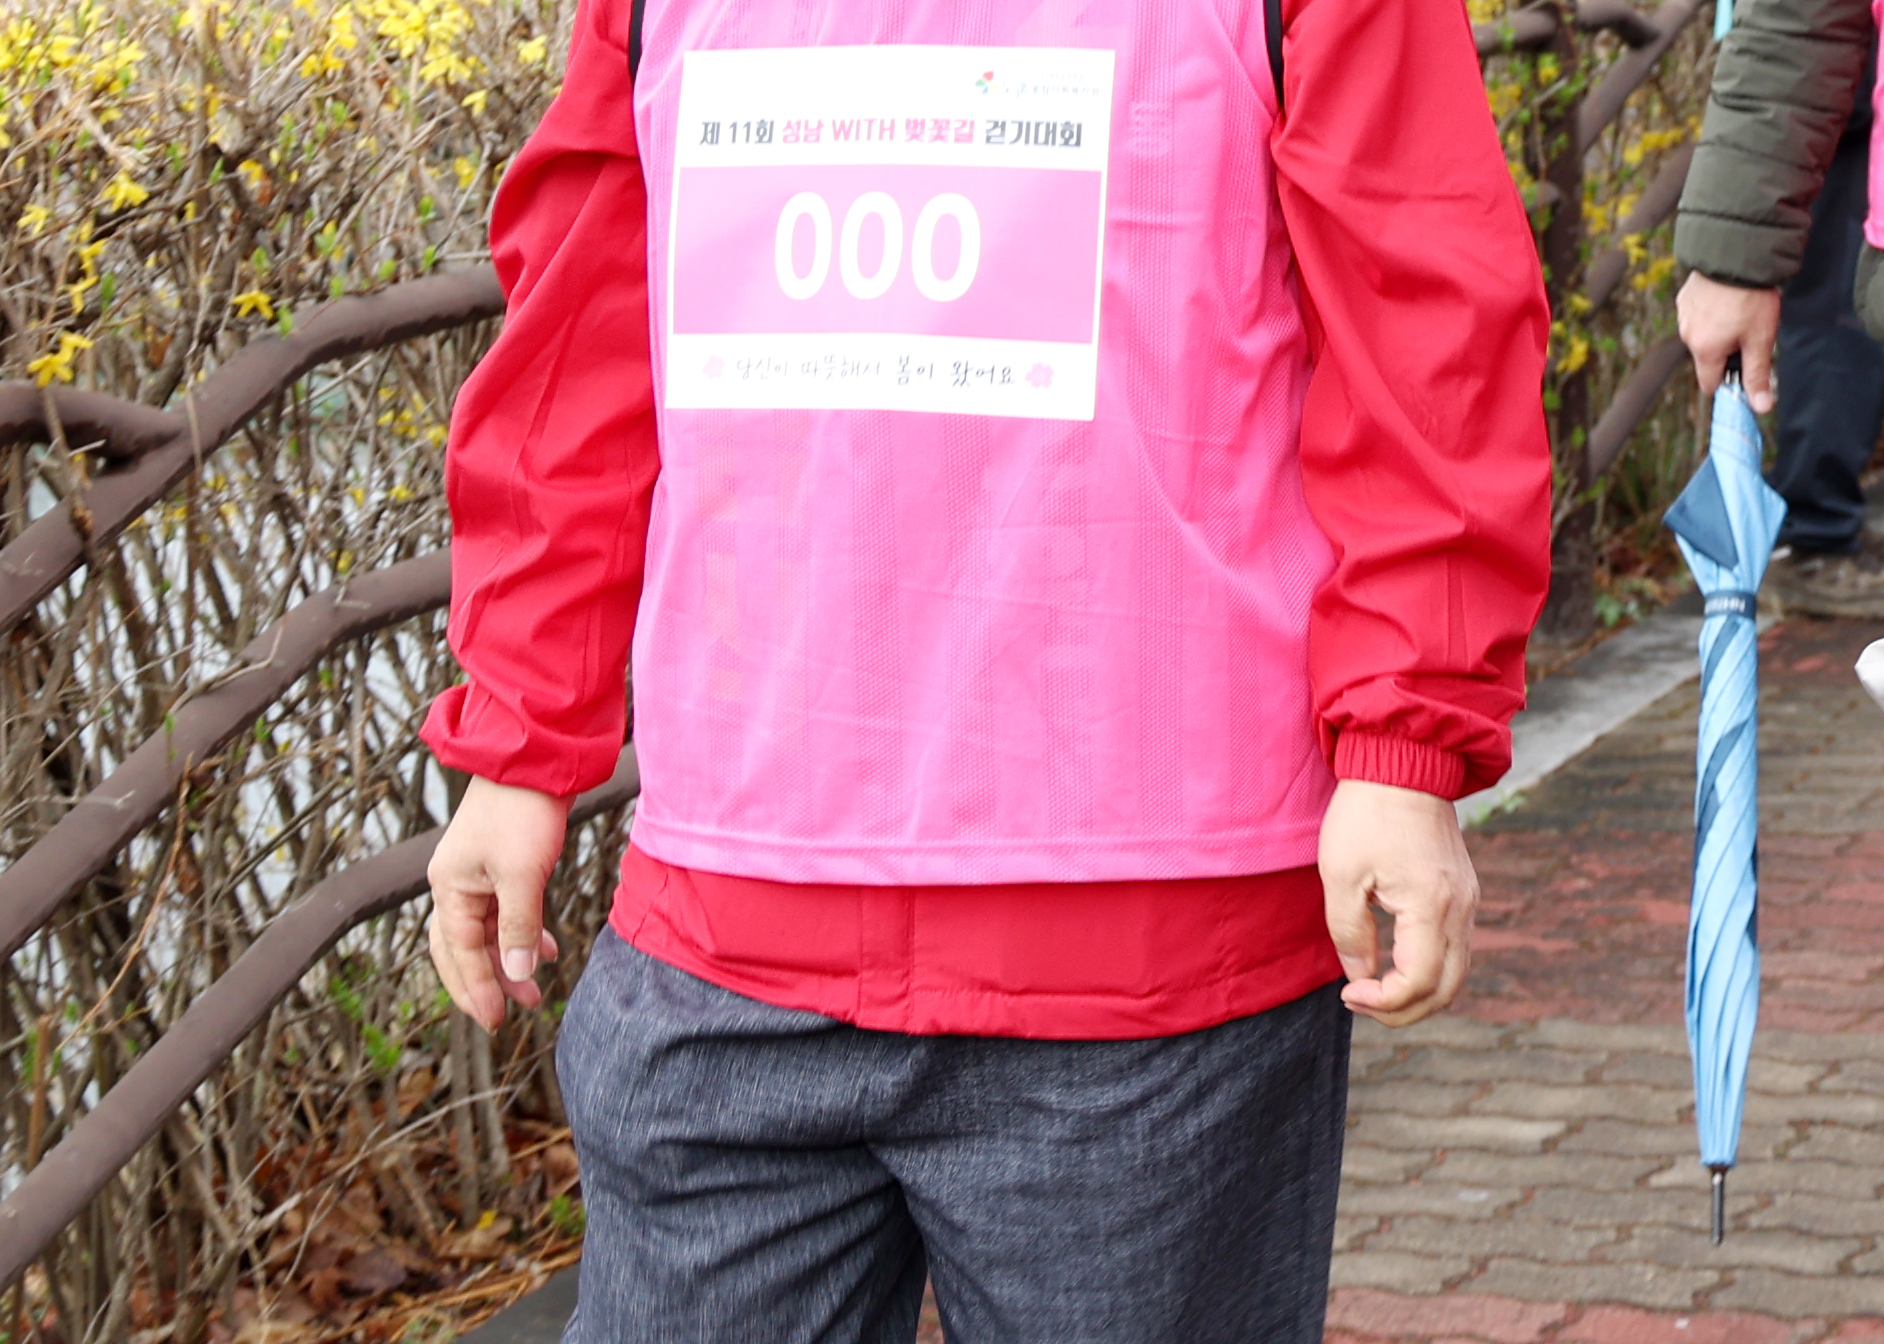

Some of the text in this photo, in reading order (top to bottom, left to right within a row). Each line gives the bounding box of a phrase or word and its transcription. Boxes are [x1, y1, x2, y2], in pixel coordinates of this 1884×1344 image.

[699, 118, 1084, 150] 제 11회 성남 WITH 벚꽃길 걷기대회
[775, 191, 982, 302] 000
[736, 353, 1017, 389] 당신이 따뜻해서 봄이 왔어요
